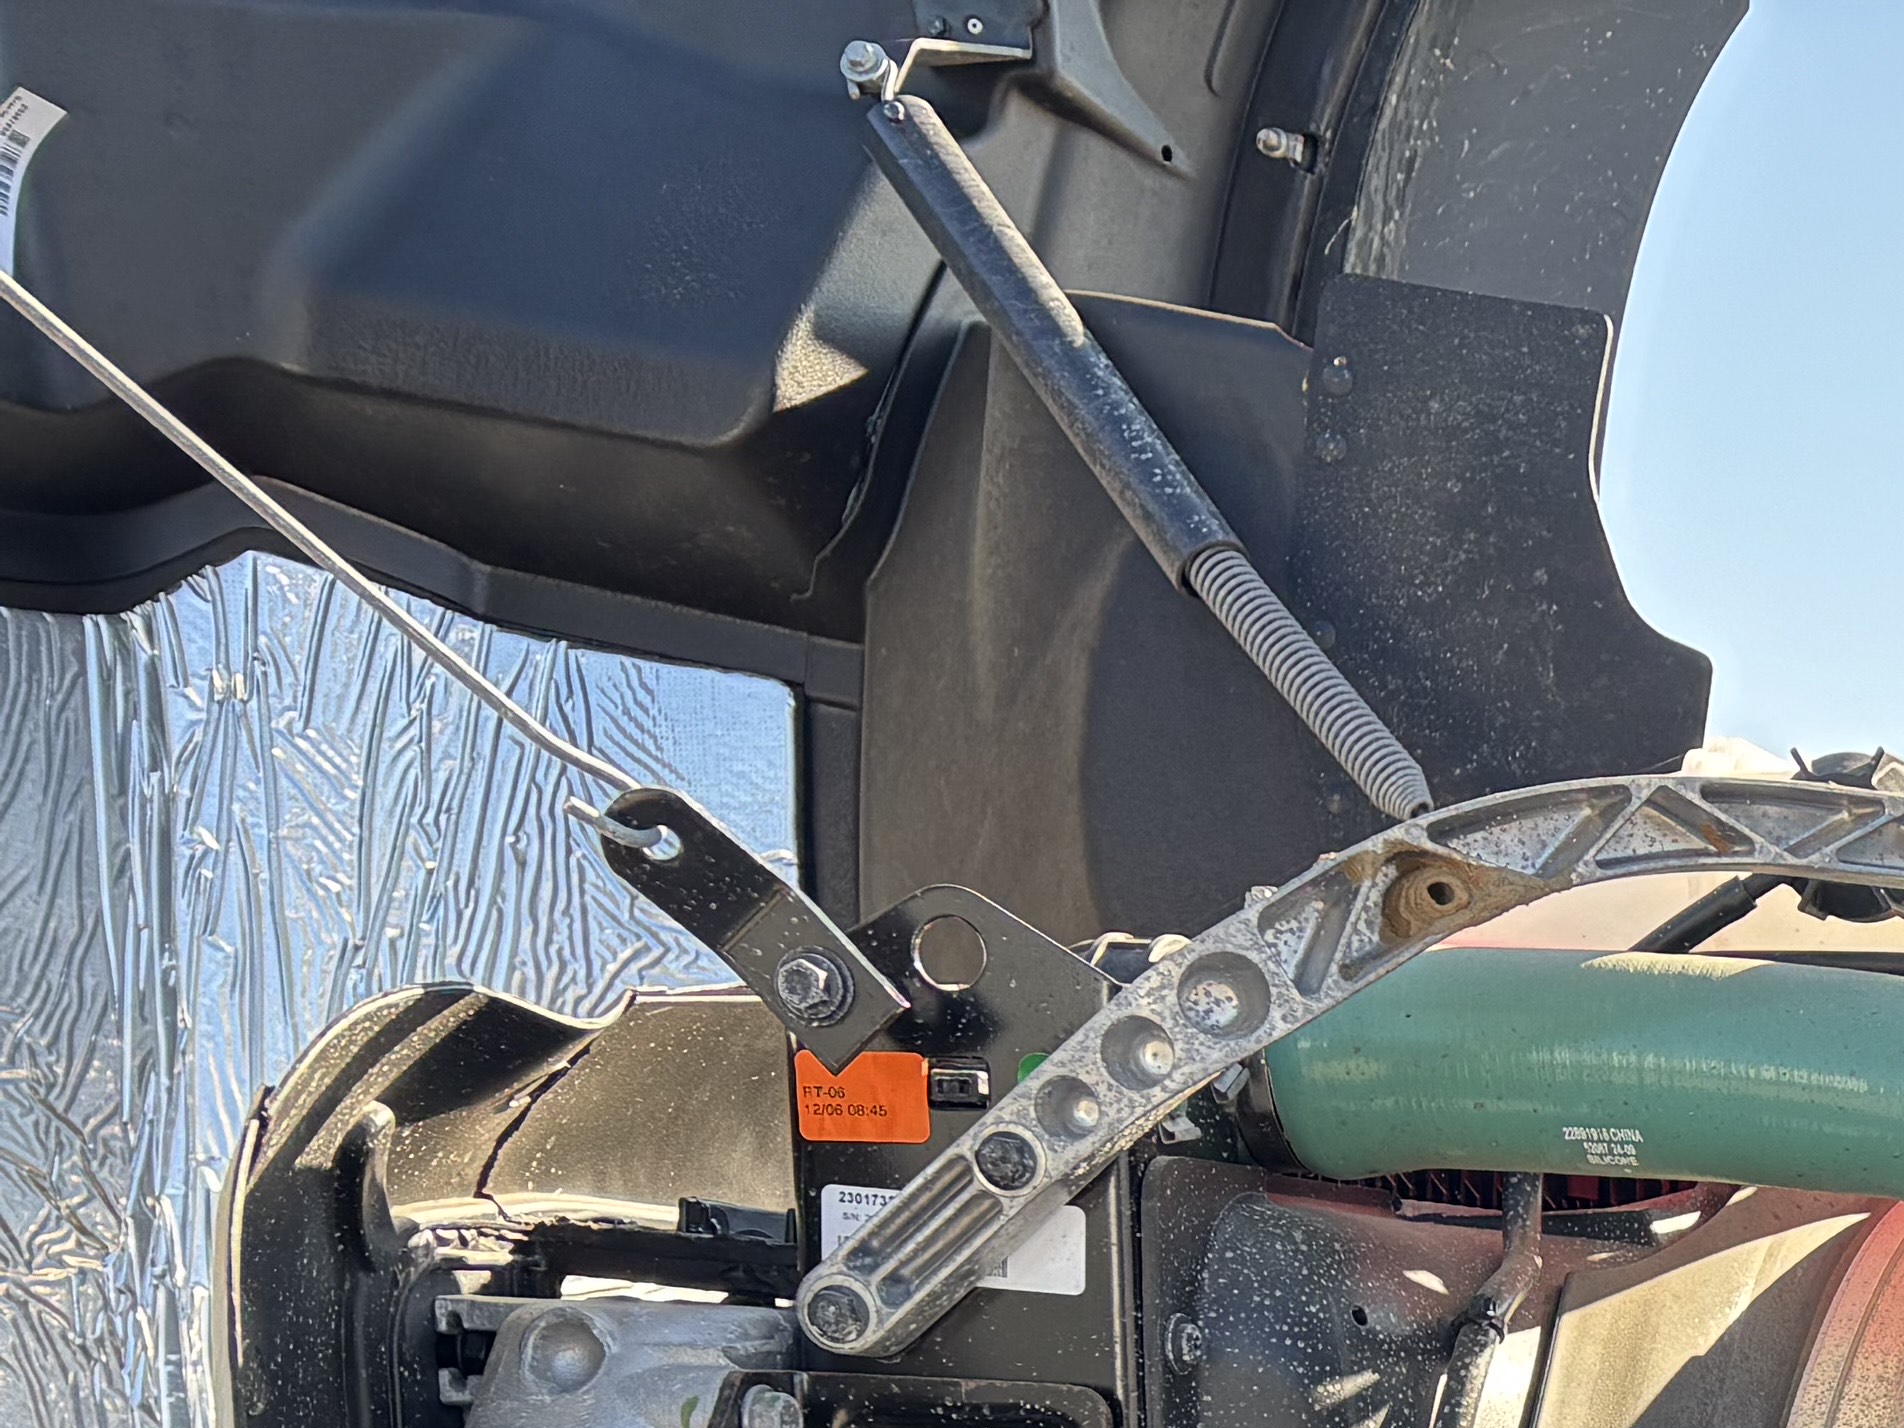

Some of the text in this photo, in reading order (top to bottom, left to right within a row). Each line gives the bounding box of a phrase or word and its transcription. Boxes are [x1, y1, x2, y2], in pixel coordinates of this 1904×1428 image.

[802, 1086, 845, 1099] RT-06
[805, 1104, 888, 1117] 12/06 08:45
[1610, 1128, 1643, 1142] CHINA
